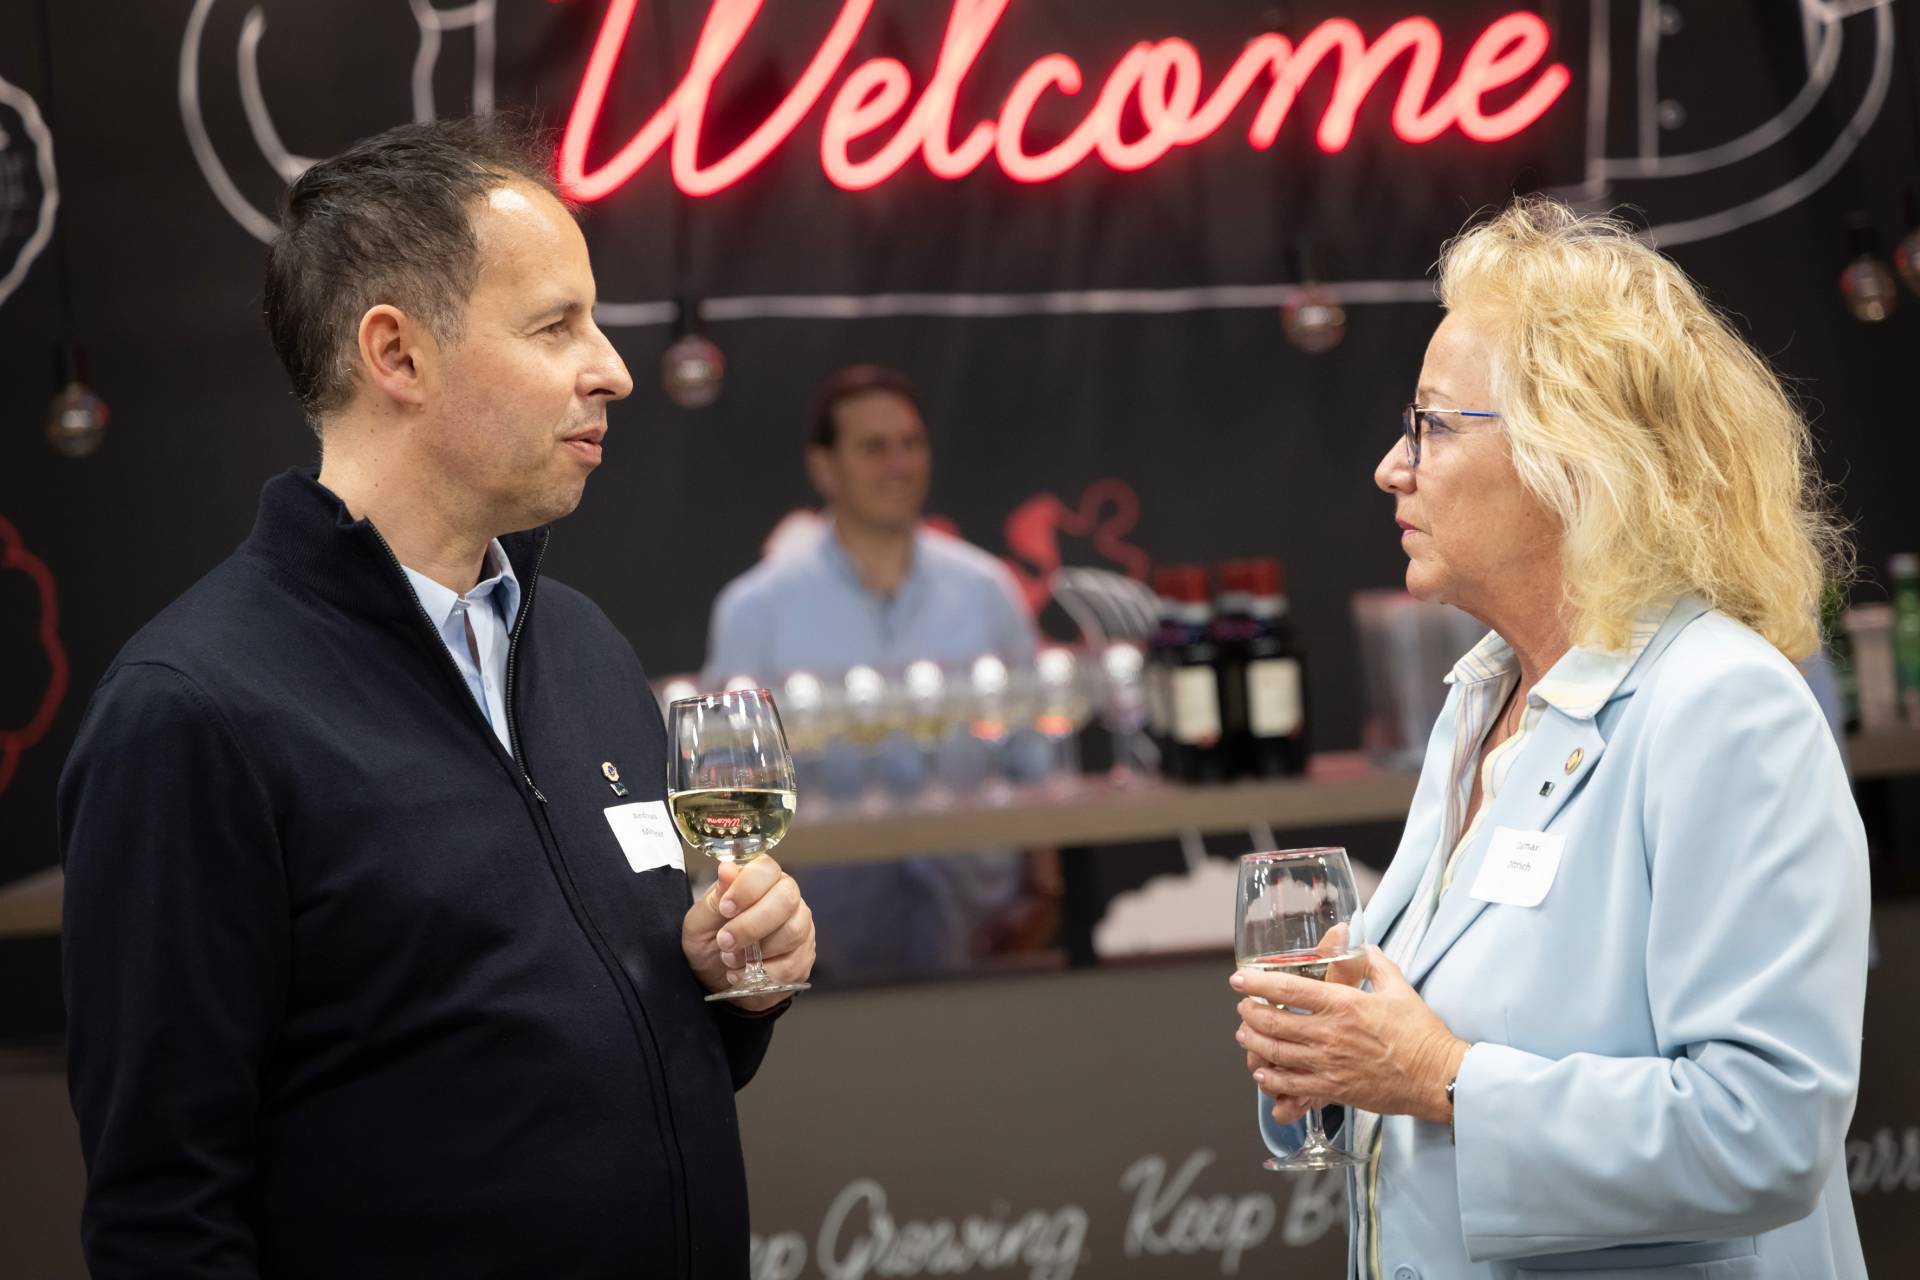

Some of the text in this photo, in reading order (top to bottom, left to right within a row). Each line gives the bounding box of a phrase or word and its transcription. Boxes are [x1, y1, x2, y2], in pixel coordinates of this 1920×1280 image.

[558, 0, 1571, 202] Welcome
[817, 1177, 1089, 1280] Growing
[1119, 1146, 1277, 1276] Keep
